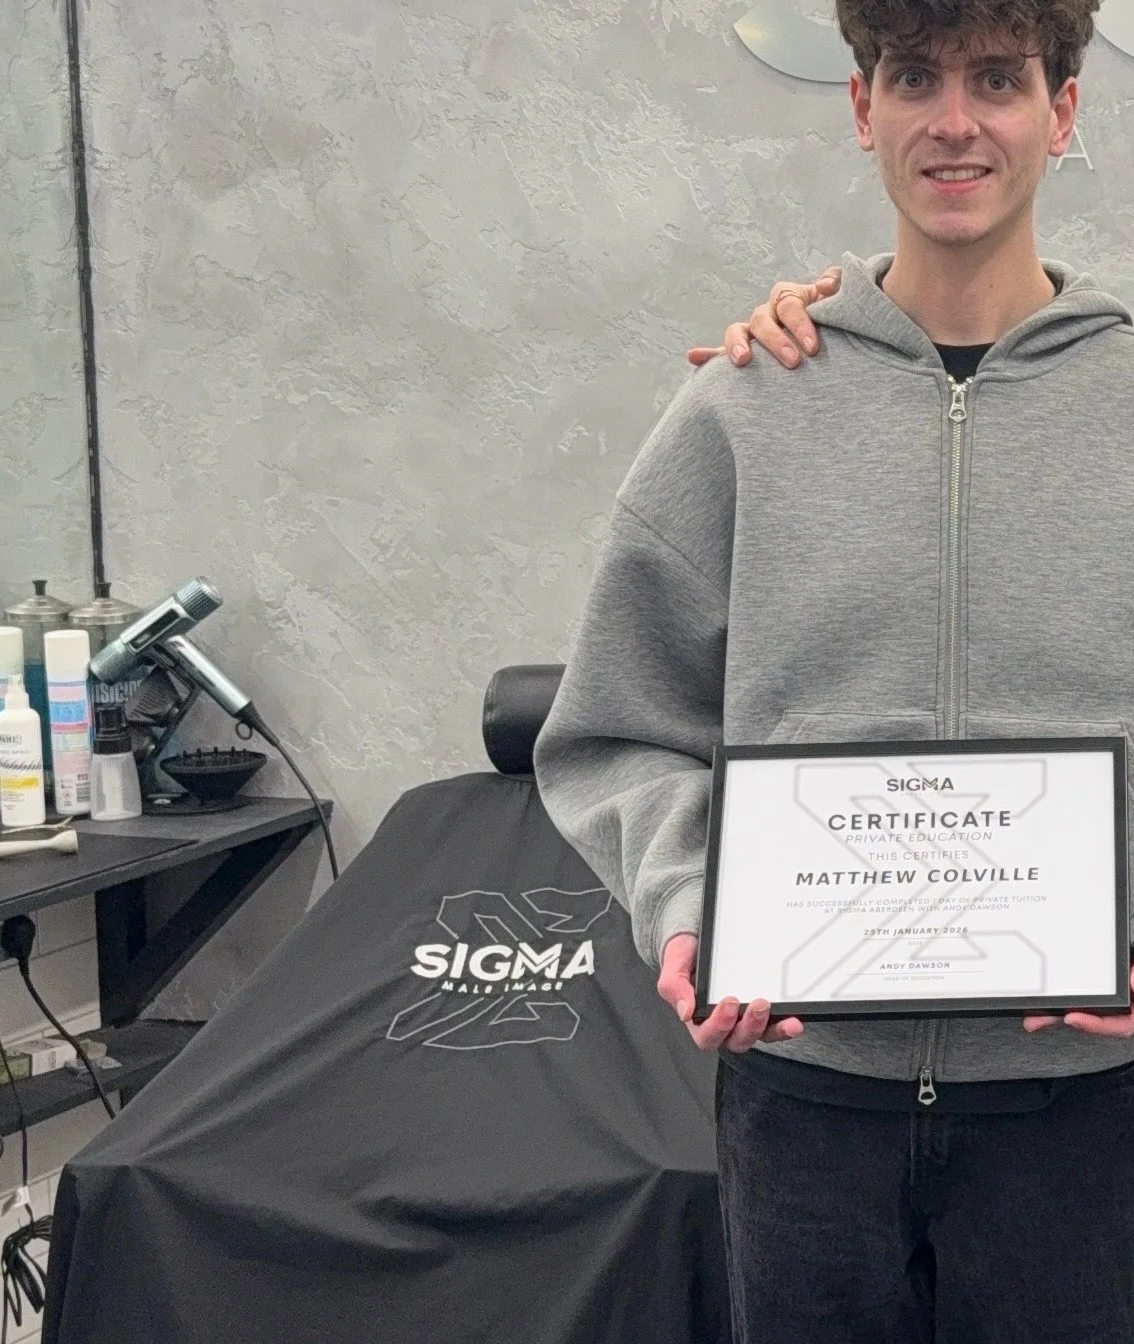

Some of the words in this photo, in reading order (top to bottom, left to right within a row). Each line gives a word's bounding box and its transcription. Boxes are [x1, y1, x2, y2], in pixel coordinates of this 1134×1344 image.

[886, 777, 954, 792] SIGMA
[828, 810, 1012, 831] CERTIFICATE
[845, 833, 902, 844] PRIVATE
[909, 831, 992, 843] EDUCATION
[868, 851, 898, 861] THIS
[903, 850, 969, 861] CERTIFIES
[795, 870, 917, 886] MATTHEW
[927, 867, 1040, 883] COLVILLE
[893, 927, 939, 936] JANUARY
[411, 940, 595, 981] SIGMA
[880, 962, 905, 970] ANDY
[909, 961, 950, 969] DAWSON
[441, 981, 493, 994] MALE
[503, 981, 563, 993] IMAGE
